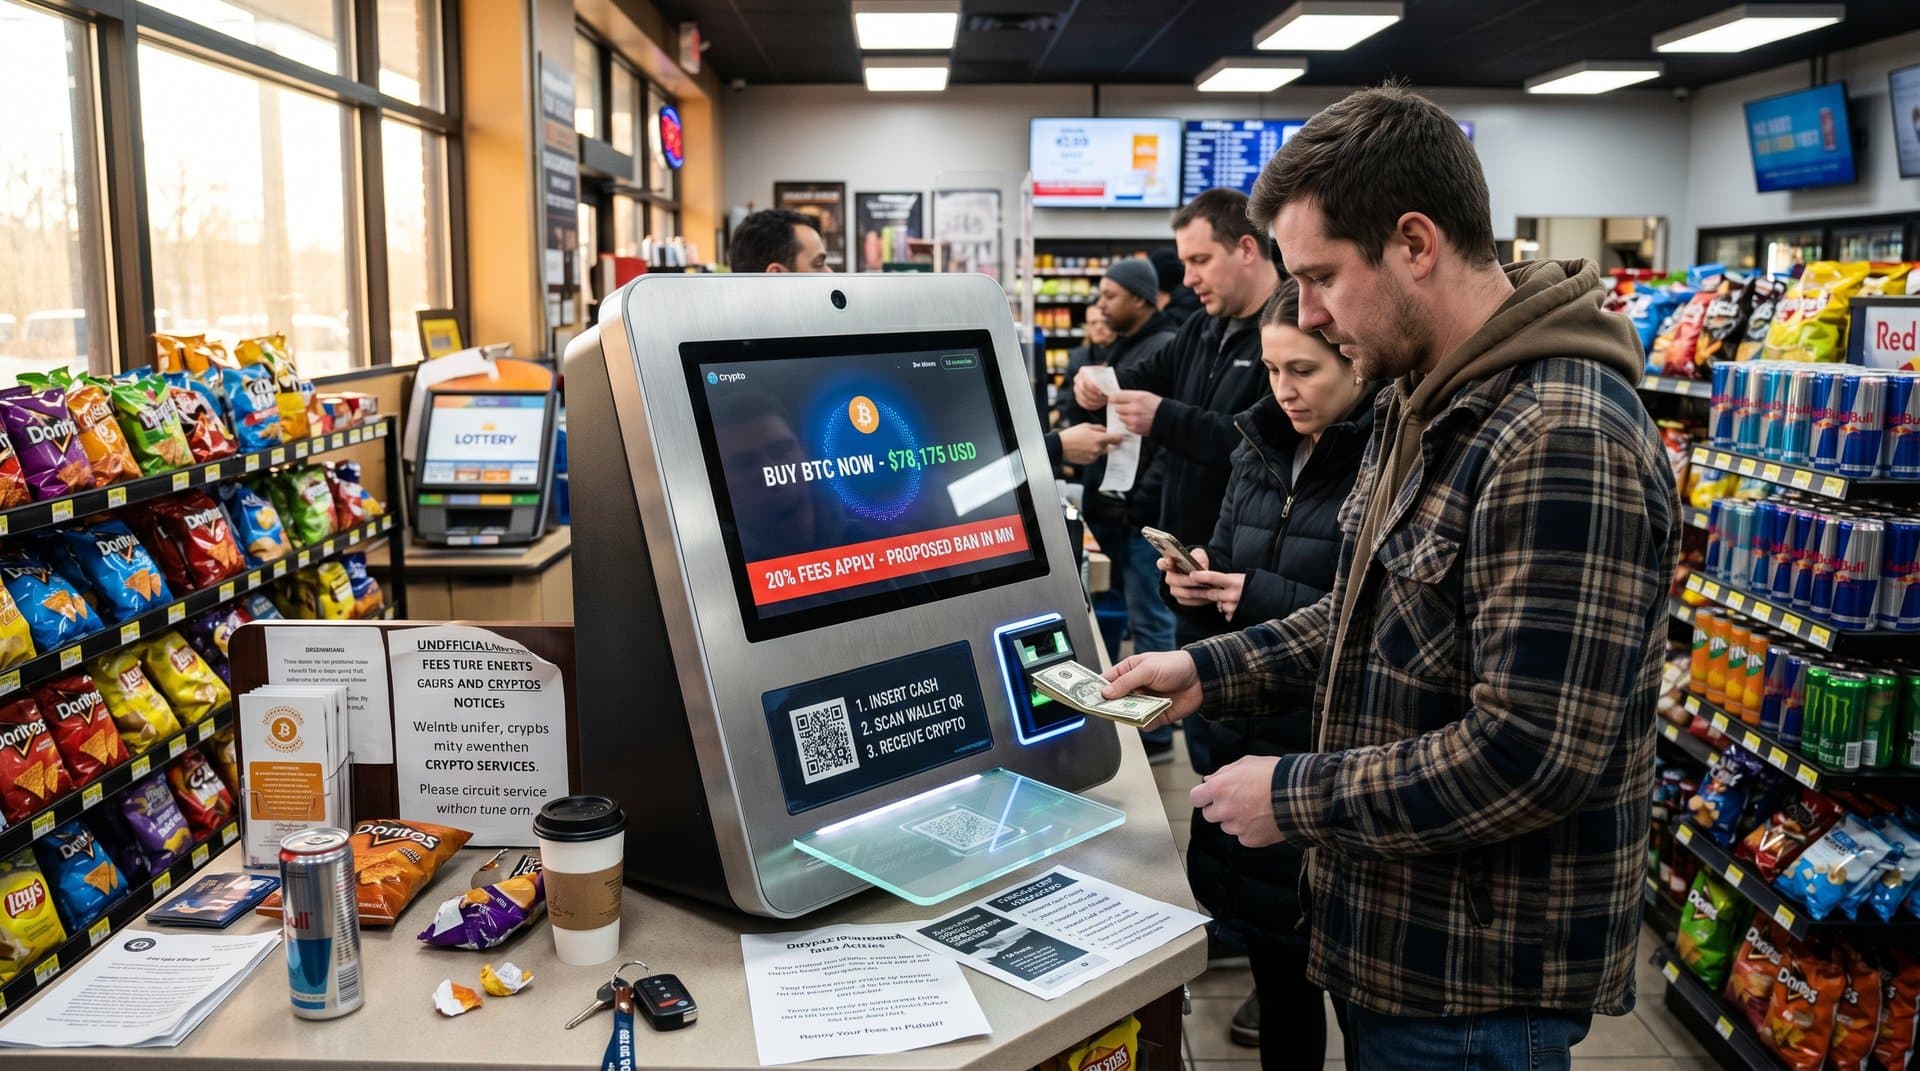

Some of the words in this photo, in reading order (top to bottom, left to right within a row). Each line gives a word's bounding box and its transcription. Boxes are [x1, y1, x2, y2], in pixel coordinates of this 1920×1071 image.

[1876, 320, 1917, 352] Red
[719, 371, 746, 383] crypto
[454, 433, 519, 445] LOTTERY
[762, 463, 797, 487] BUY
[801, 458, 836, 482] BTC
[836, 453, 875, 477] NOW
[888, 444, 946, 473] $78,175
[947, 441, 977, 462] USD
[764, 567, 797, 590] 20%
[797, 560, 833, 583] FEES
[835, 552, 876, 577] APPLY
[885, 540, 952, 566] PROPOSED
[953, 533, 980, 552] BAN
[981, 530, 995, 547] IN
[995, 526, 1016, 544] MN
[422, 659, 451, 670] FEES
[452, 659, 483, 671] TURE
[487, 660, 534, 672] ENERTS
[457, 679, 484, 689] AND
[487, 679, 541, 690] CRYPTOS
[855, 698, 868, 713] 1.
[868, 685, 907, 710] INSERT
[909, 676, 939, 698] CASH
[56, 688, 103, 720] Doritos
[860, 720, 873, 737] 2.
[873, 709, 905, 732] SCAN
[905, 697, 947, 723] WALLET
[948, 693, 965, 711] QR
[461, 721, 504, 735] unifer,
[866, 743, 879, 759] 3.
[879, 728, 925, 755] RECEIVE
[925, 715, 966, 741] CRYPTO
[434, 740, 463, 753] mity
[425, 759, 474, 771] CRYPTO
[476, 760, 540, 772] SERVICES.
[419, 783, 460, 796] Please
[462, 784, 501, 797] circuit
[503, 785, 548, 798] service
[479, 804, 507, 816] tune
[509, 806, 534, 816] orn.
[354, 824, 439, 850] Doritos
